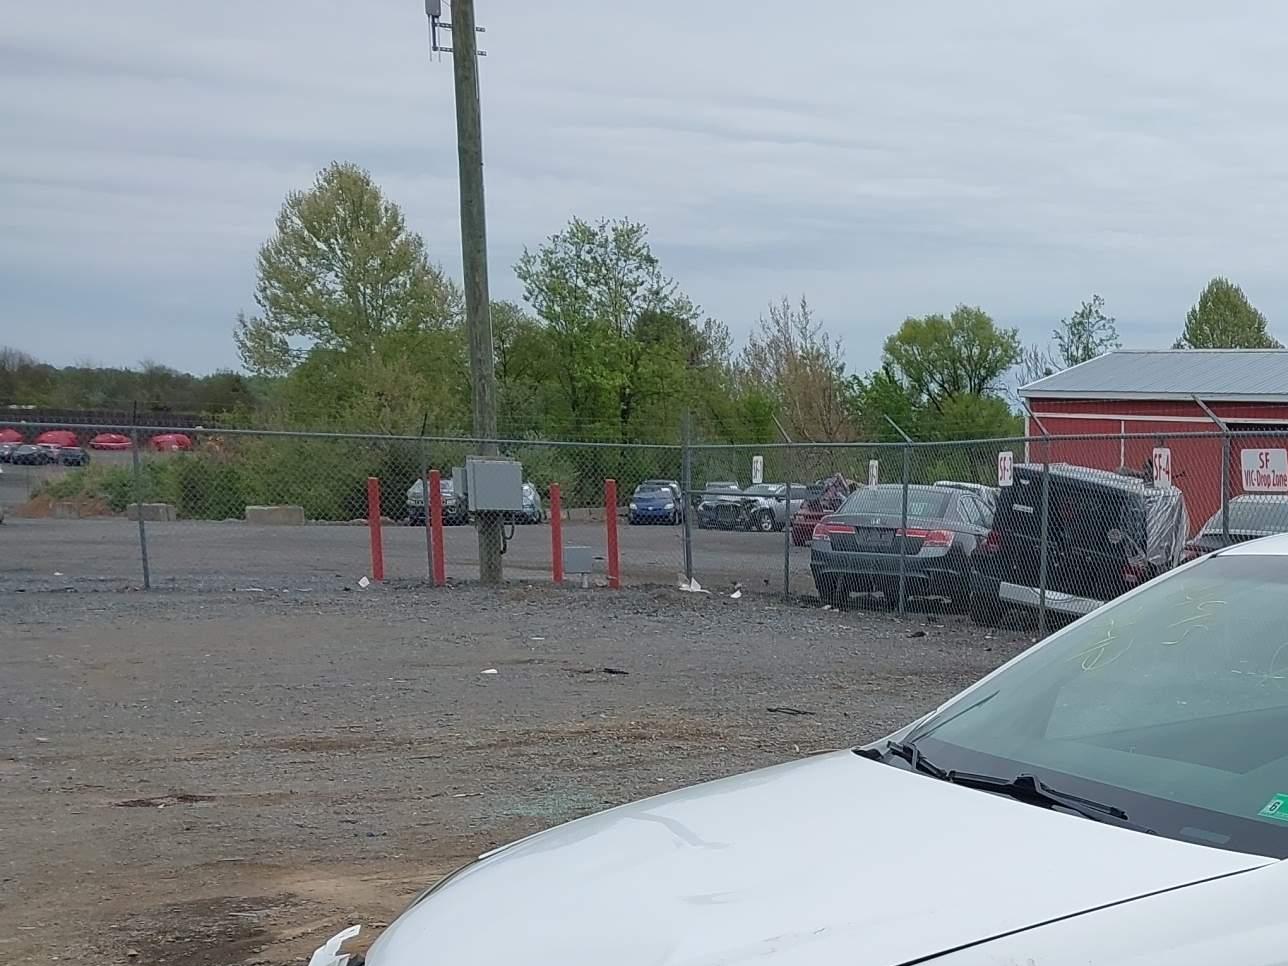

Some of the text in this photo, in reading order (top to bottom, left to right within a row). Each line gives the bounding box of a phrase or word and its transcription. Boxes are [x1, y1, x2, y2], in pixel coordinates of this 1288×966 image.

[1154, 453, 1169, 480] SF-4
[1258, 452, 1270, 469] SF
[1272, 470, 1288, 487] Zone
